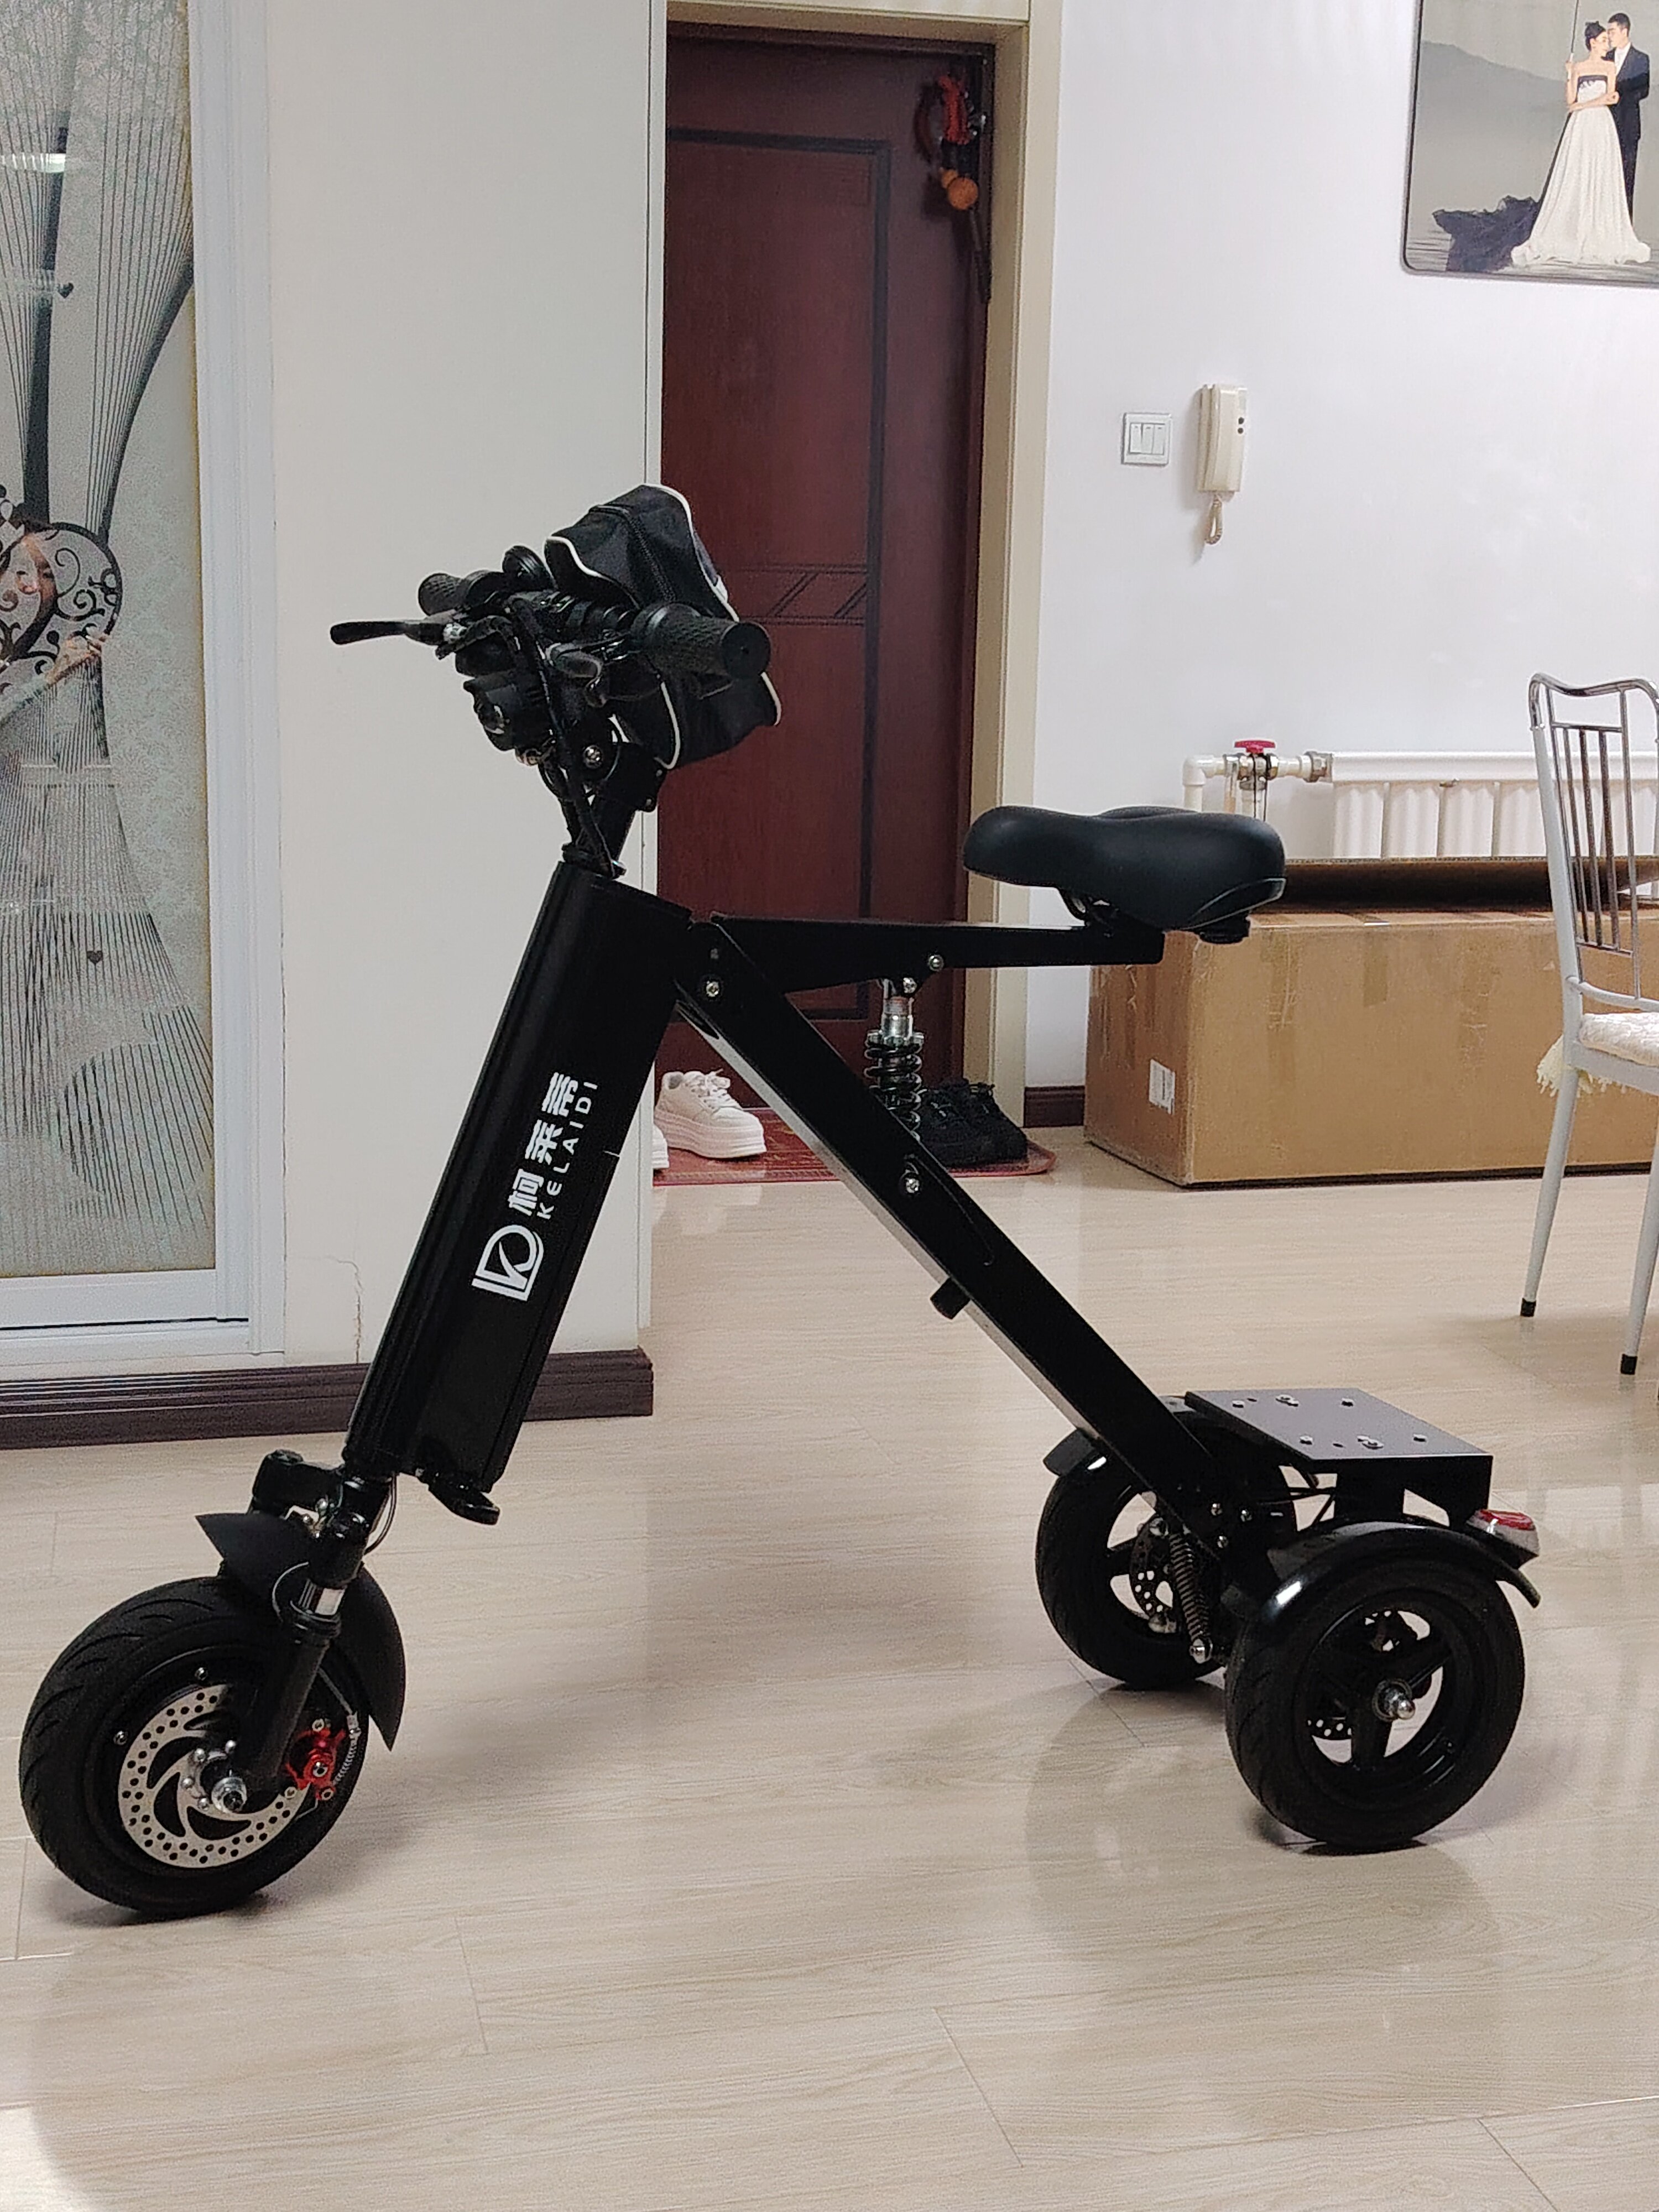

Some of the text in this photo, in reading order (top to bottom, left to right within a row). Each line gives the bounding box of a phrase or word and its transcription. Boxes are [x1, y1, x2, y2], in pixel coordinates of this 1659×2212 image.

[507, 1072, 578, 1216] 柯莱蒂
[537, 1082, 598, 1219] KELAIDI
